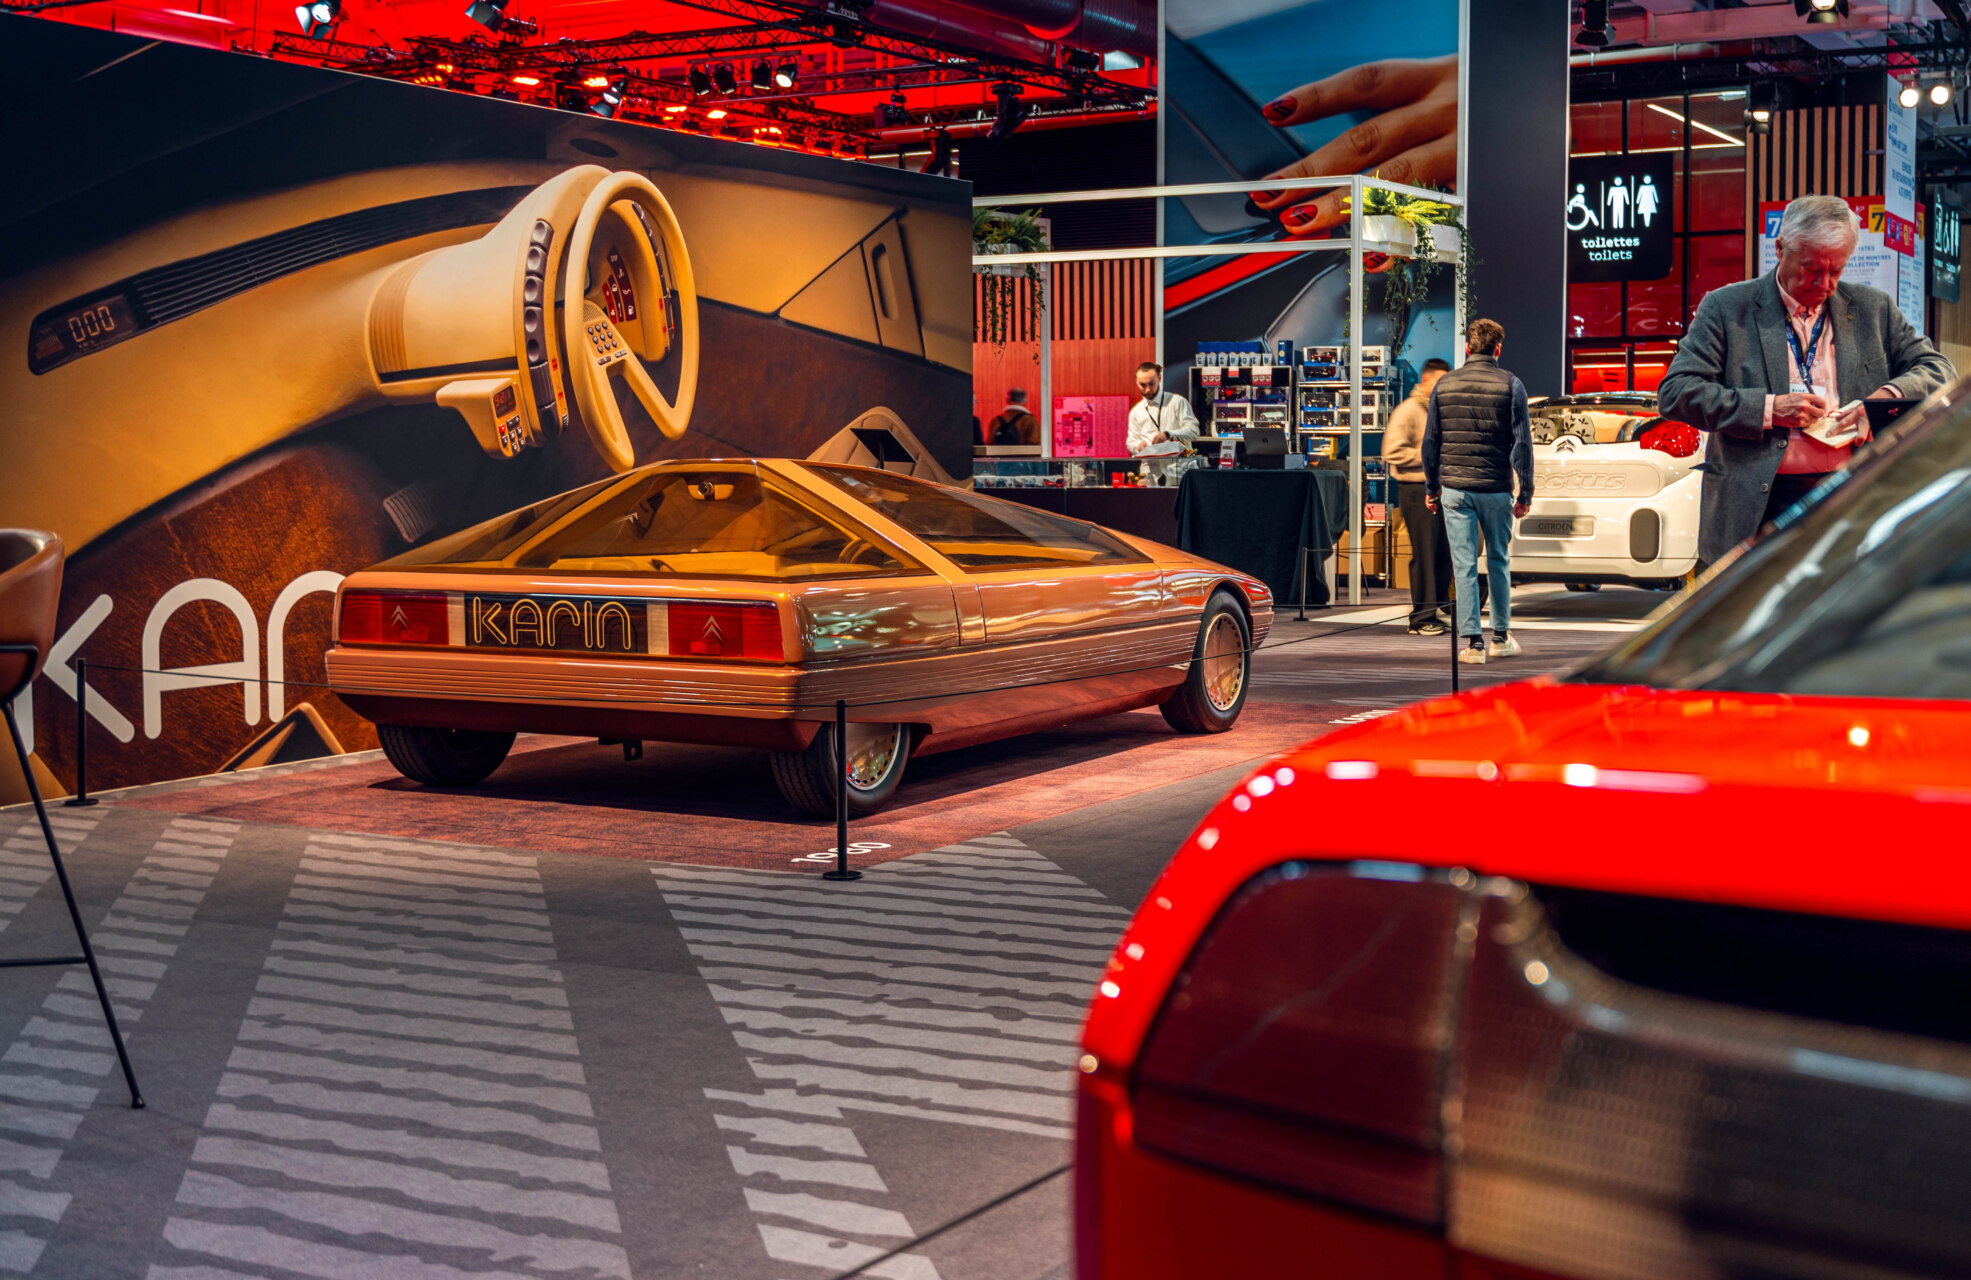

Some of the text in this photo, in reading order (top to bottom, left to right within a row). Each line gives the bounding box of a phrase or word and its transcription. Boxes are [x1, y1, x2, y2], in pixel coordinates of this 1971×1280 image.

[1581, 236, 1640, 248] toilettes
[1589, 249, 1633, 261] toilets
[13, 570, 346, 757] KAR
